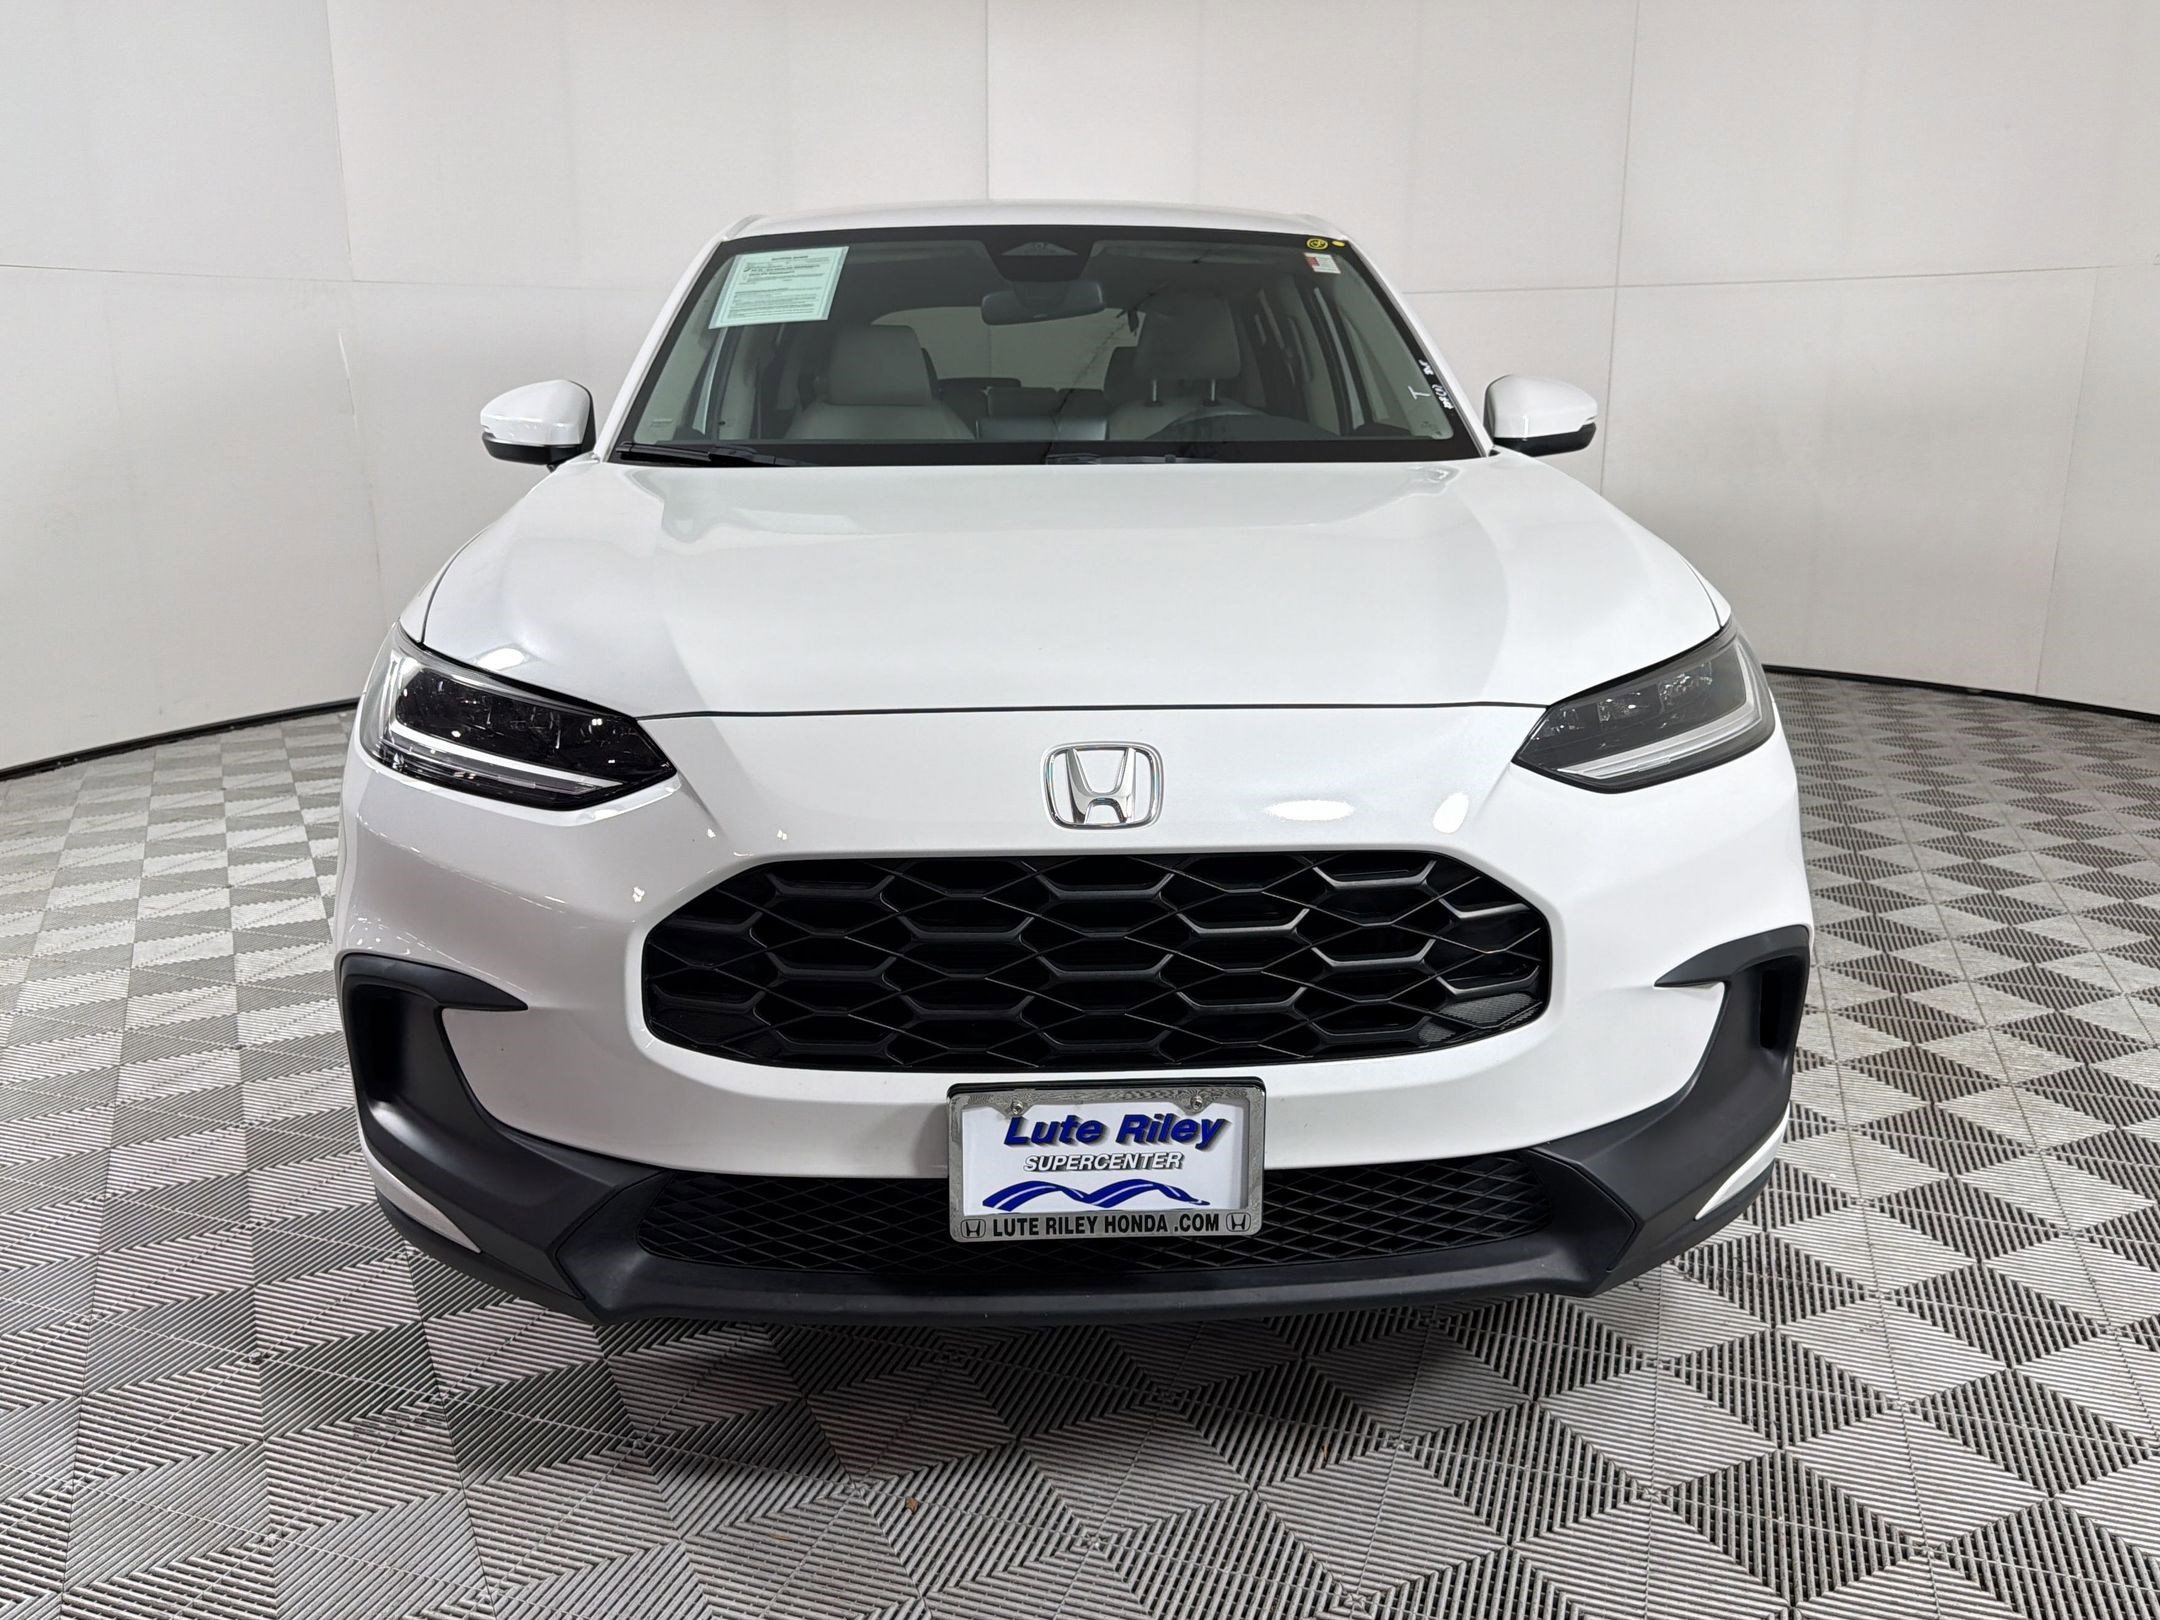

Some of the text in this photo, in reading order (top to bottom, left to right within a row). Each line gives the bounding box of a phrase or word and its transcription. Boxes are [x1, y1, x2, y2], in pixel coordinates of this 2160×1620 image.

[1003, 1112, 1229, 1150] Lute Riley
[1023, 1152, 1184, 1172] SUPERCENTER
[993, 1217, 1039, 1237] LUTE
[1045, 1215, 1097, 1235] RILEY
[1104, 1214, 1168, 1233] HONDA
[1174, 1213, 1220, 1232] .COM
